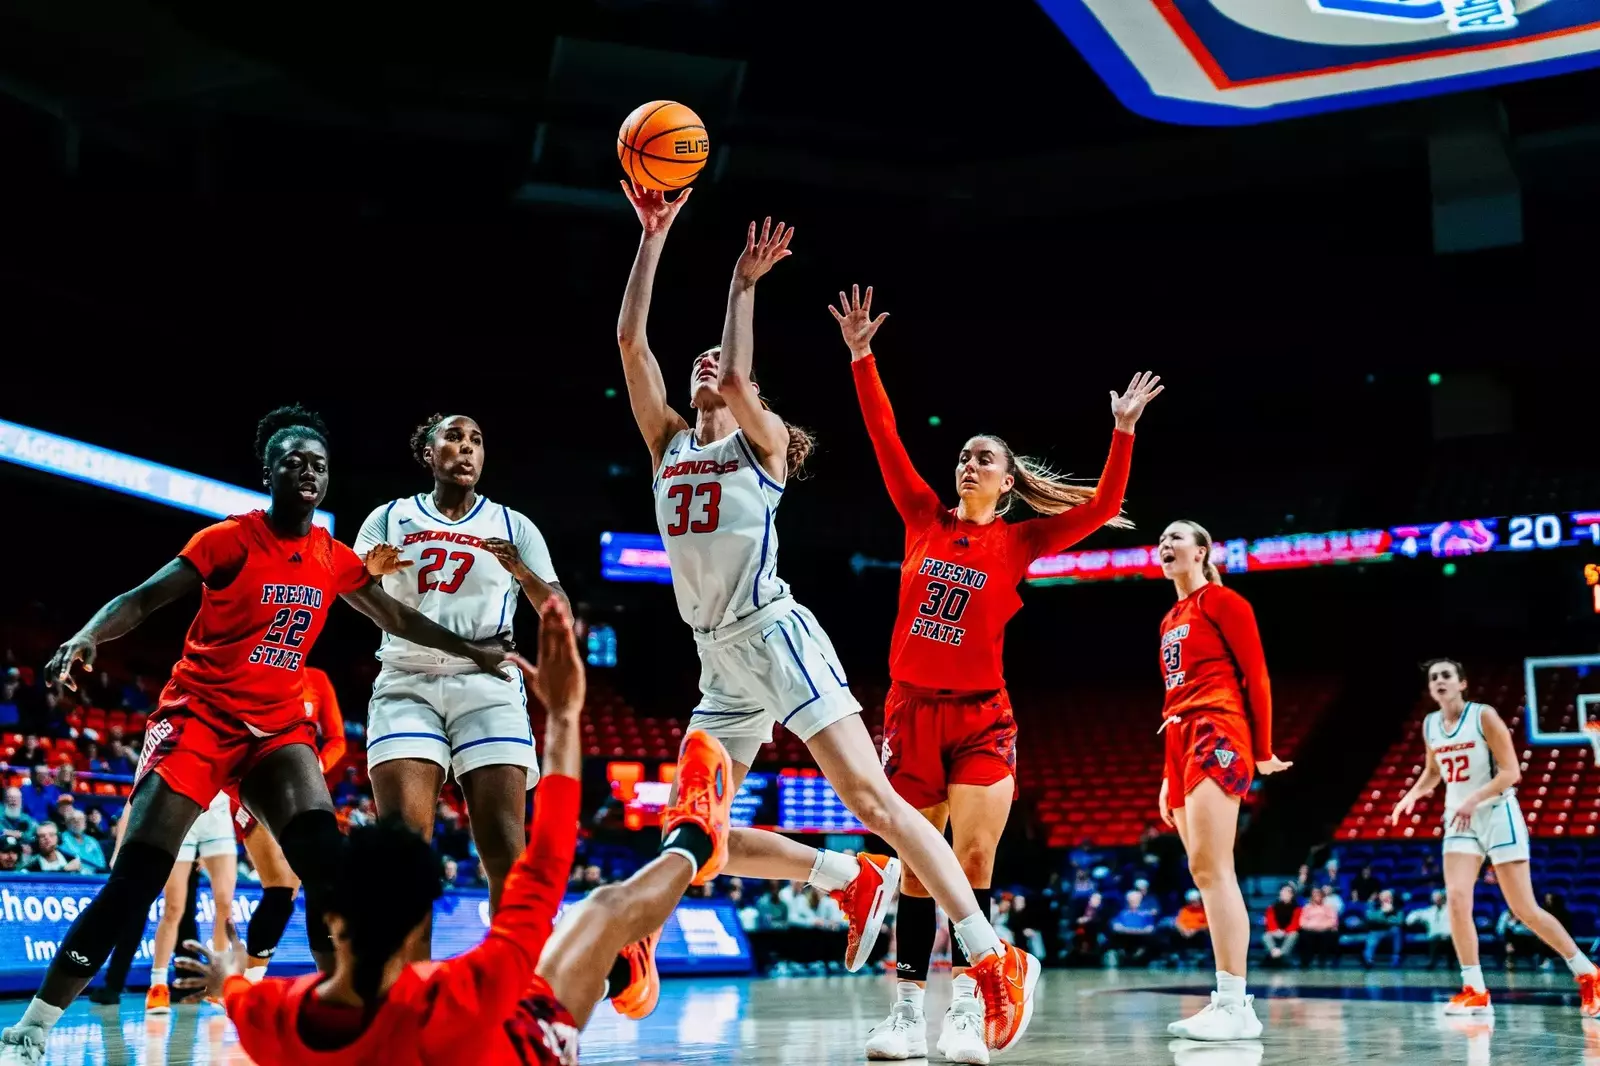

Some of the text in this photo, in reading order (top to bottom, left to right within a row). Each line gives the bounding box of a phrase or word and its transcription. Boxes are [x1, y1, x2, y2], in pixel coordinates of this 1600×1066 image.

[674, 140, 708, 154] ELITE
[668, 482, 722, 537] 33
[403, 530, 486, 549] BRONCO
[1508, 515, 1561, 549] 20
[418, 547, 475, 594] 23
[919, 557, 988, 590] FRESNO
[261, 583, 323, 609] FRESNO
[919, 580, 971, 623] 30
[261, 607, 313, 648] 22
[910, 617, 966, 646] STATE
[248, 644, 303, 672] STATE
[1441, 755, 1470, 783] 32
[0, 888, 93, 922] hoos
